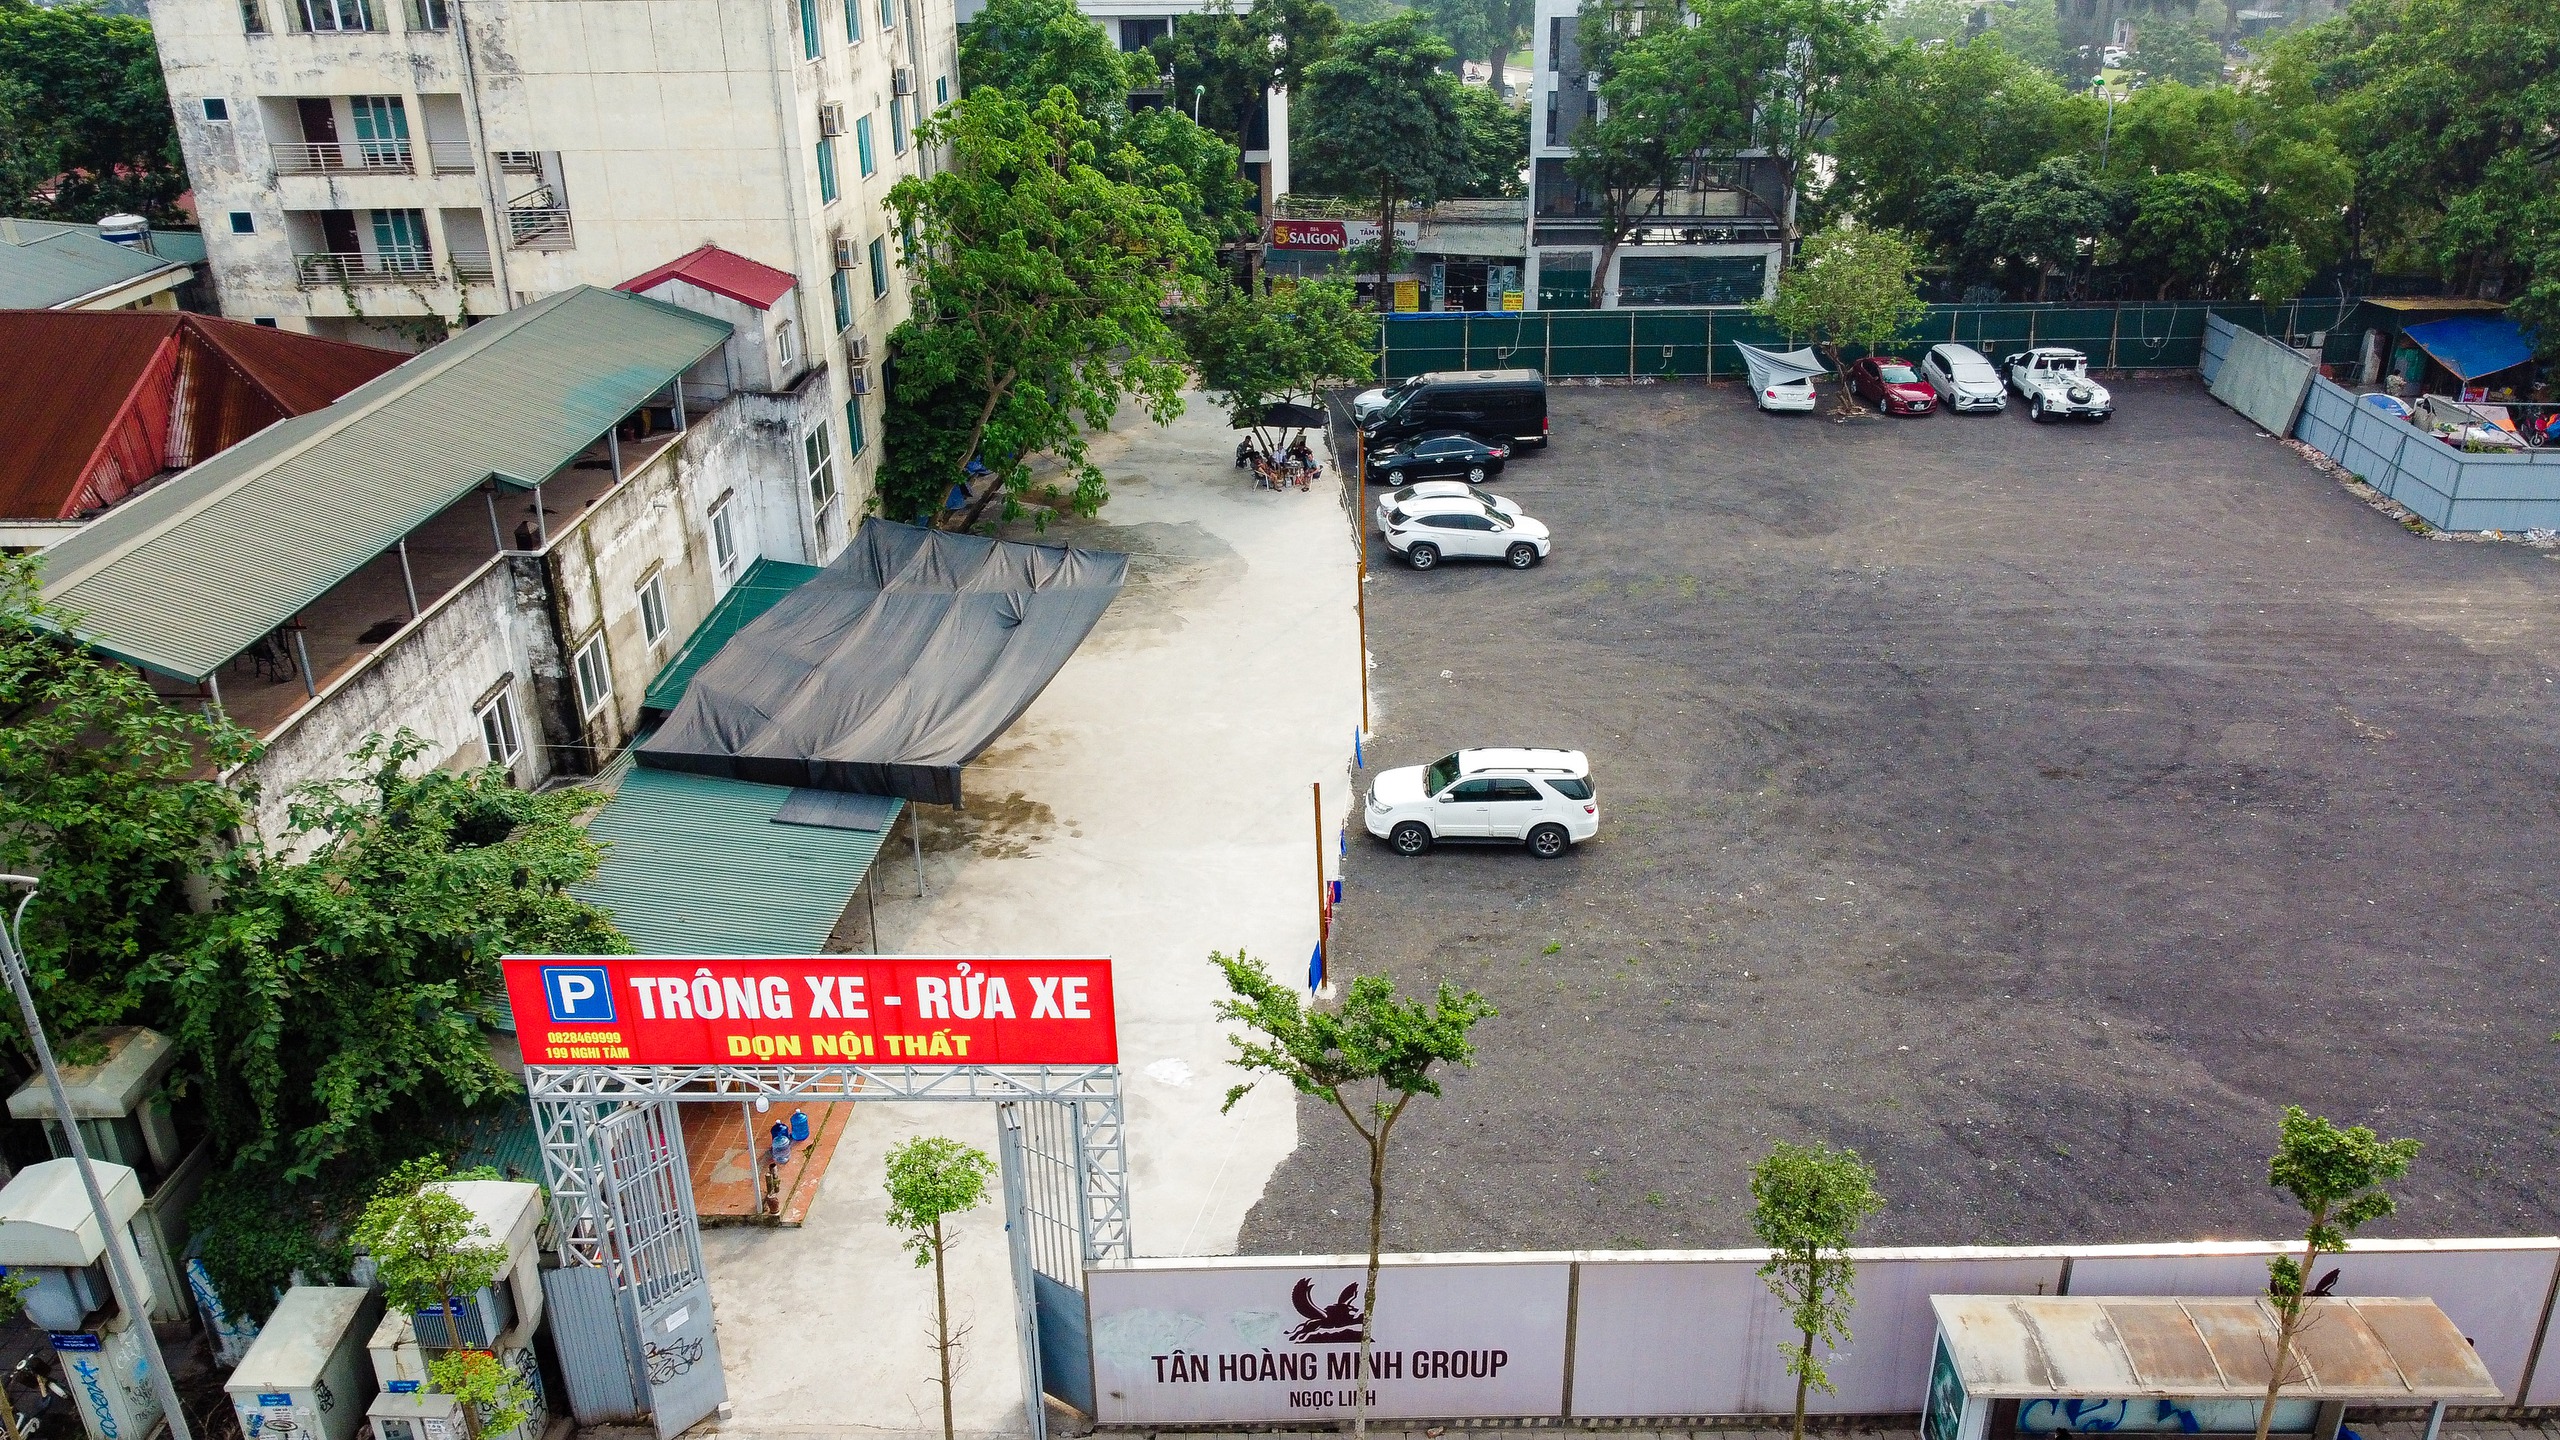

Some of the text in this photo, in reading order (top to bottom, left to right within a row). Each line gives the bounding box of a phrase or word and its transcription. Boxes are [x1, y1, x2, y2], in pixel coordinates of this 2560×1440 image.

[1289, 232, 1340, 245] SAIGON
[558, 975, 595, 1014] P
[629, 962, 1091, 1020] TRÔNG XE - RỬA XE
[548, 1032, 621, 1044] 0828469999
[727, 1028, 971, 1061] DỌN NỘI THẤT
[546, 1045, 630, 1059] 199 NGHI TÀM
[1151, 1350, 1210, 1383] TÂN
[1218, 1347, 1317, 1382] HOÀNG
[1412, 1349, 1508, 1379] GROUP
[1289, 1390, 1334, 1410] NGỌC
